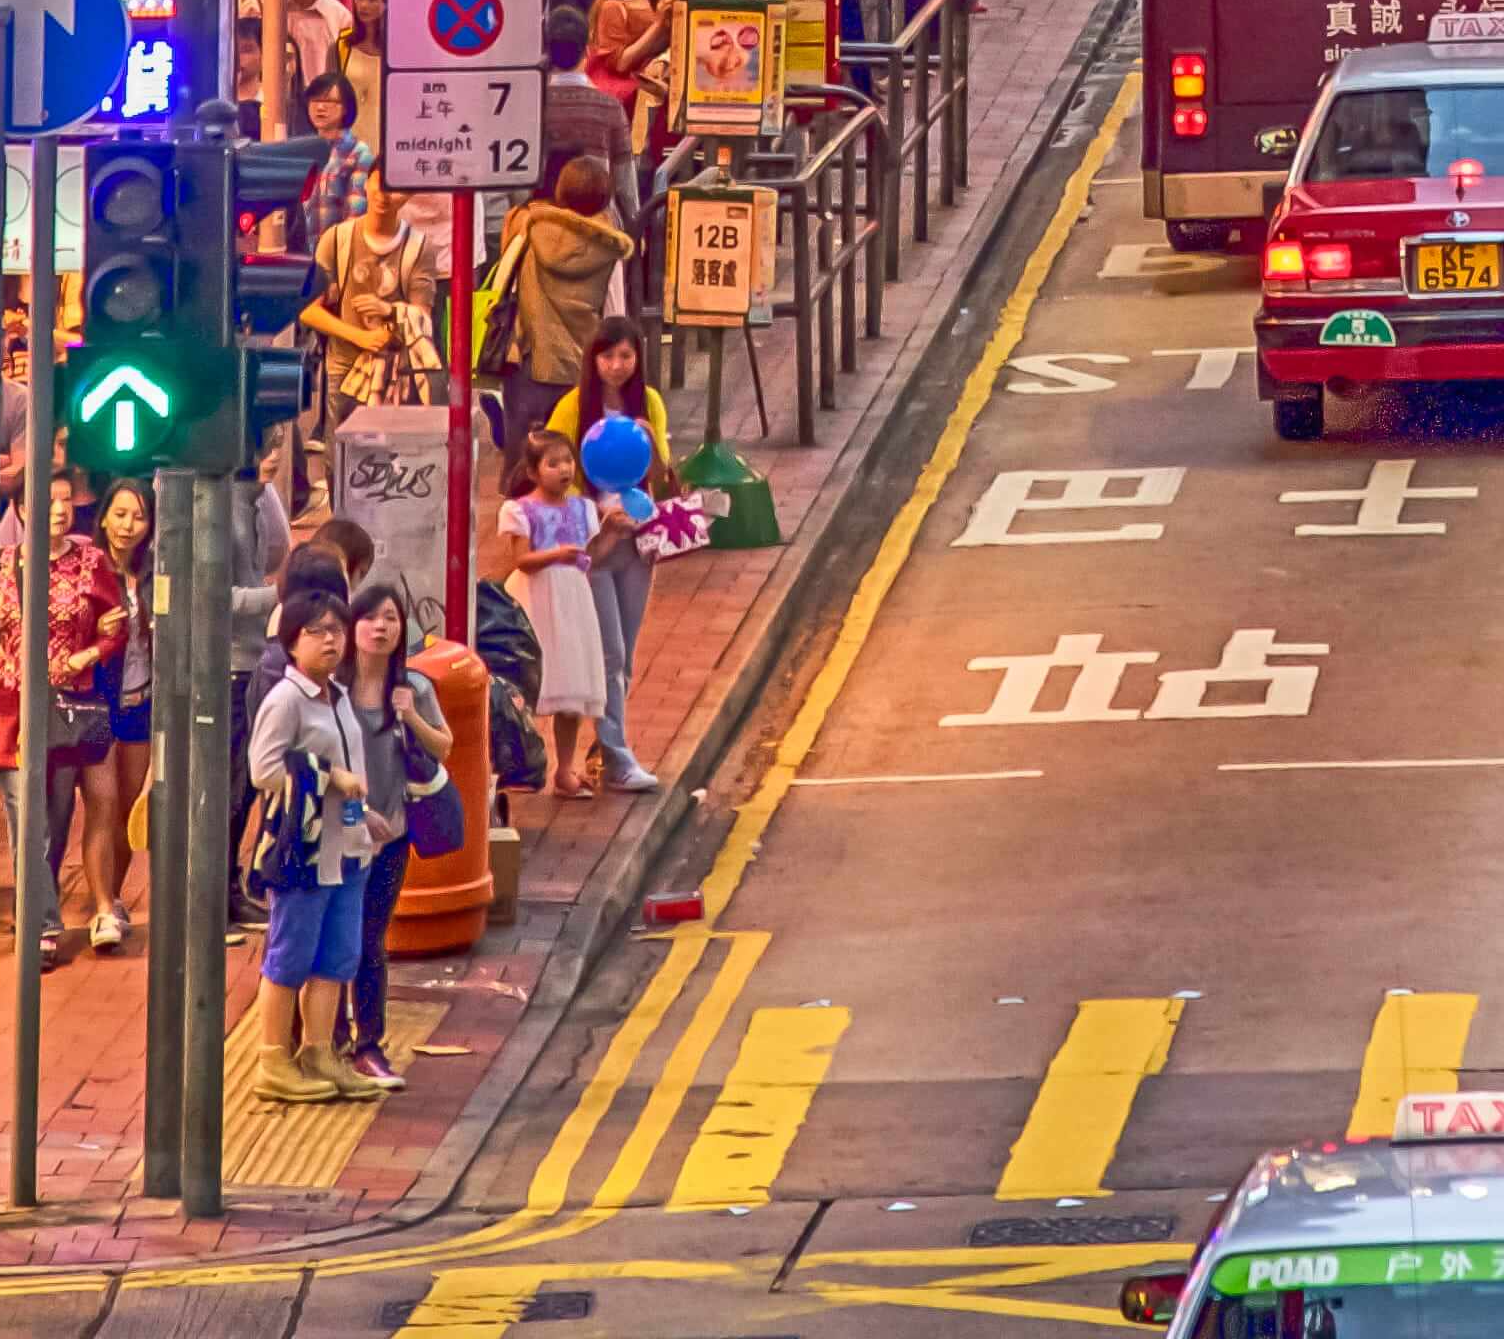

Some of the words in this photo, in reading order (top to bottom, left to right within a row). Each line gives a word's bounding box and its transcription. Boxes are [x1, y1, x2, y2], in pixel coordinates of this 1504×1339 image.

[421, 80, 448, 95] am
[487, 82, 512, 117] 7
[414, 99, 456, 121] 上午
[395, 137, 474, 155] midnight
[488, 139, 530, 173] 12
[692, 224, 739, 250] 12B
[1423, 267, 1492, 290] 6574
[951, 457, 1479, 549] 巴士
